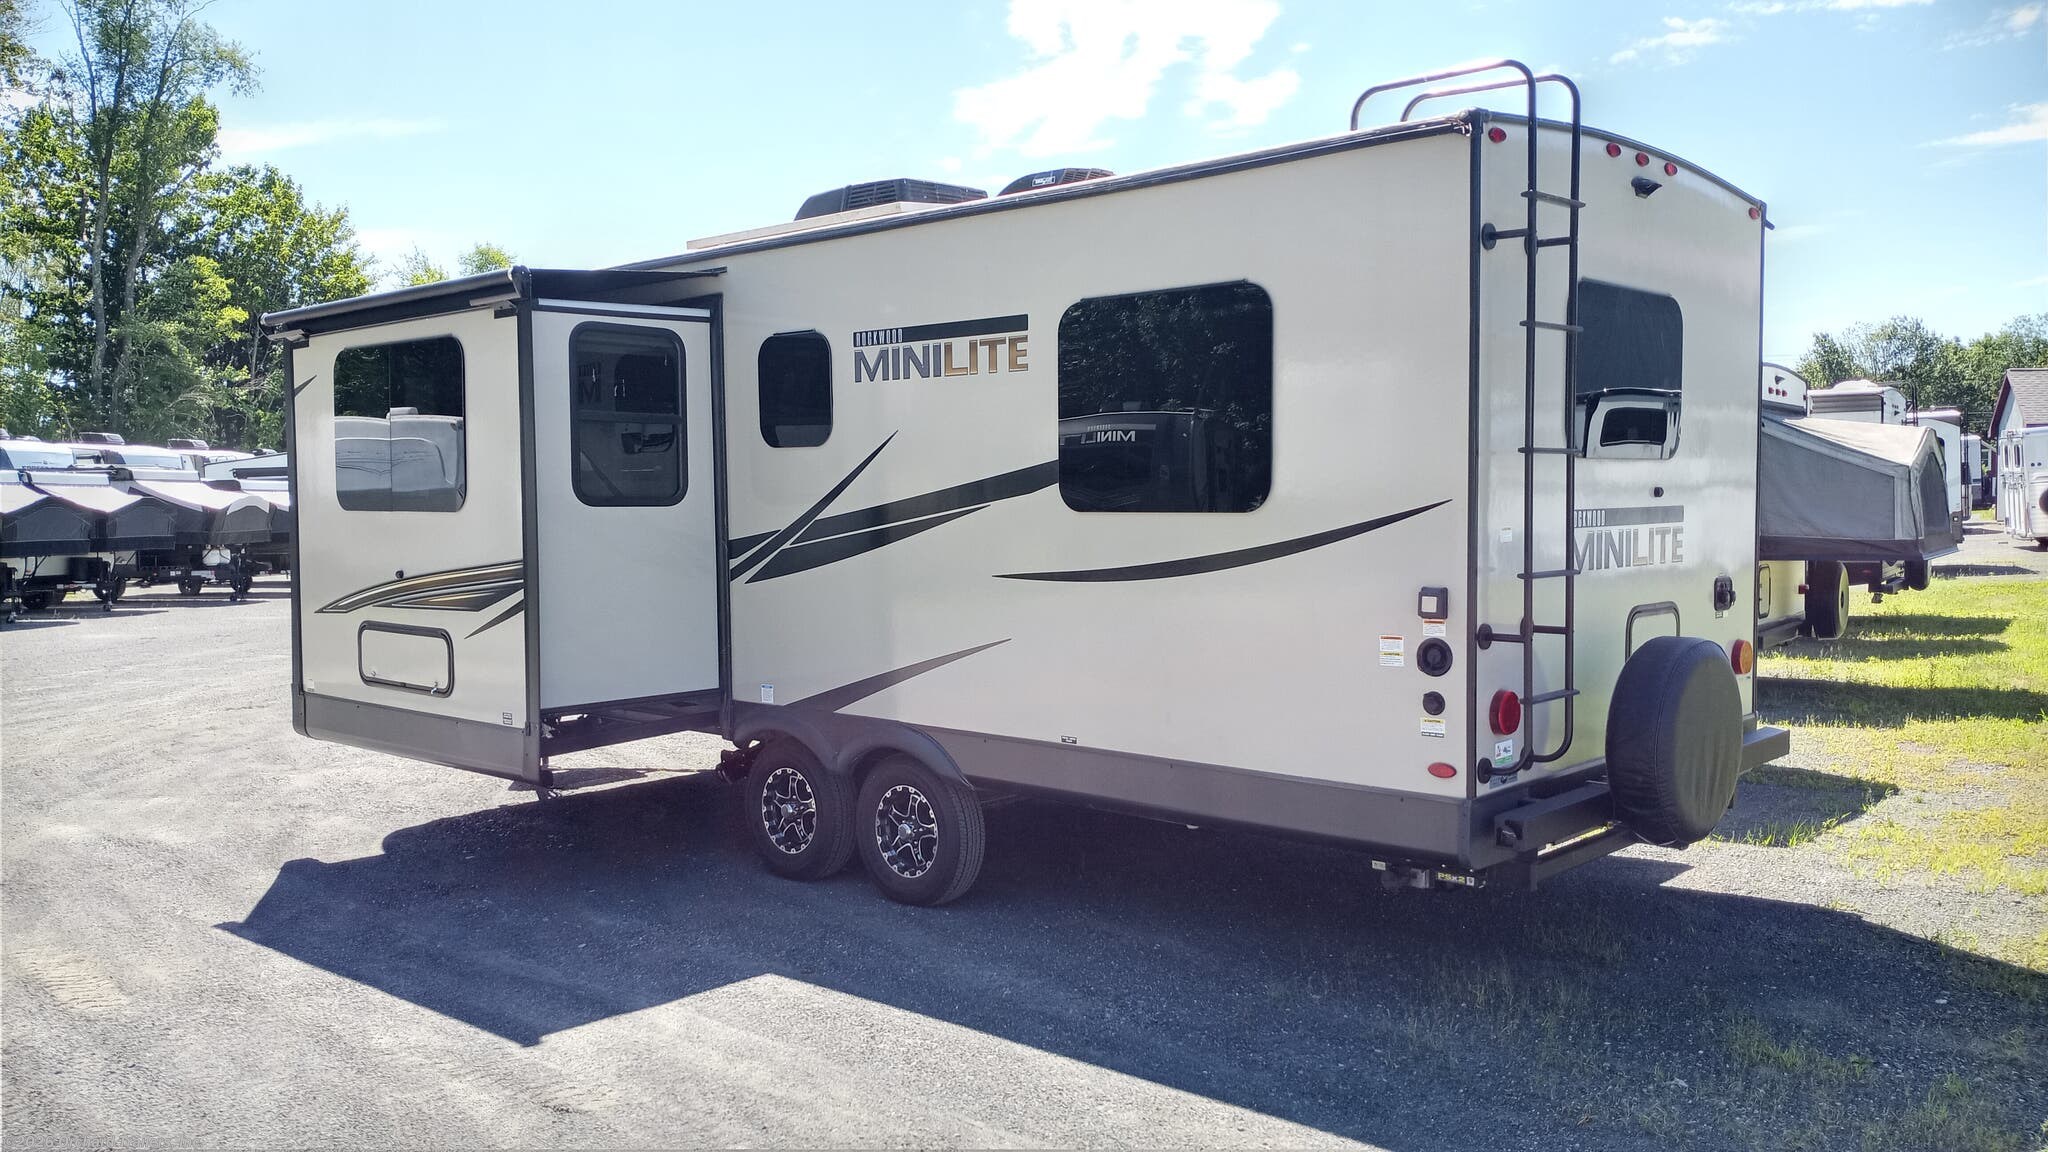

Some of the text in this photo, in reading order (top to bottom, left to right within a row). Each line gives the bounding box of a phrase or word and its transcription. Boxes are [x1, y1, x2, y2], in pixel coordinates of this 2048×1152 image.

[855, 329, 903, 347] ROCKWOOD
[854, 334, 1029, 383] MINILITE
[1574, 509, 1606, 528] OCKWOOD
